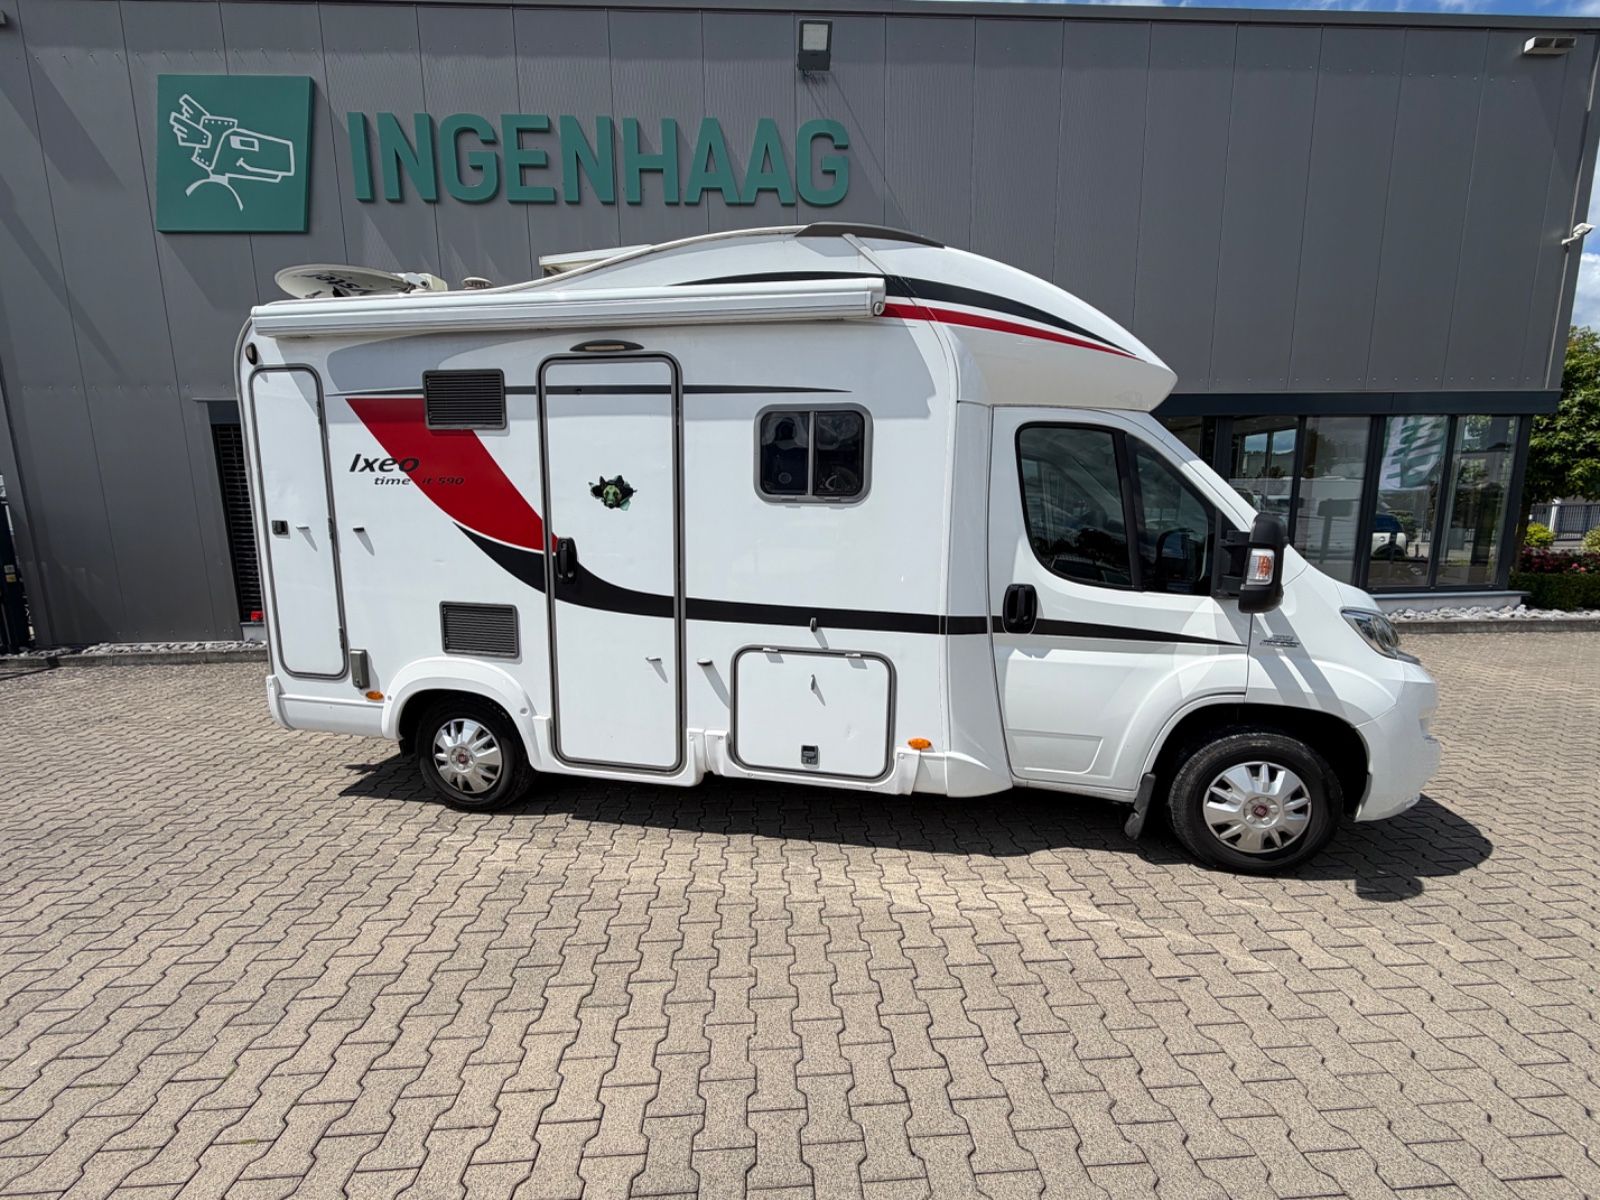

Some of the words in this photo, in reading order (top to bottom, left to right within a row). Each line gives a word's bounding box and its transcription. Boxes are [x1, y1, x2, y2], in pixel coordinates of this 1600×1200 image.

[347, 111, 849, 207] INGENHAAG
[349, 453, 420, 473] Ixeo
[374, 476, 411, 486] time
[438, 477, 465, 486] 590
